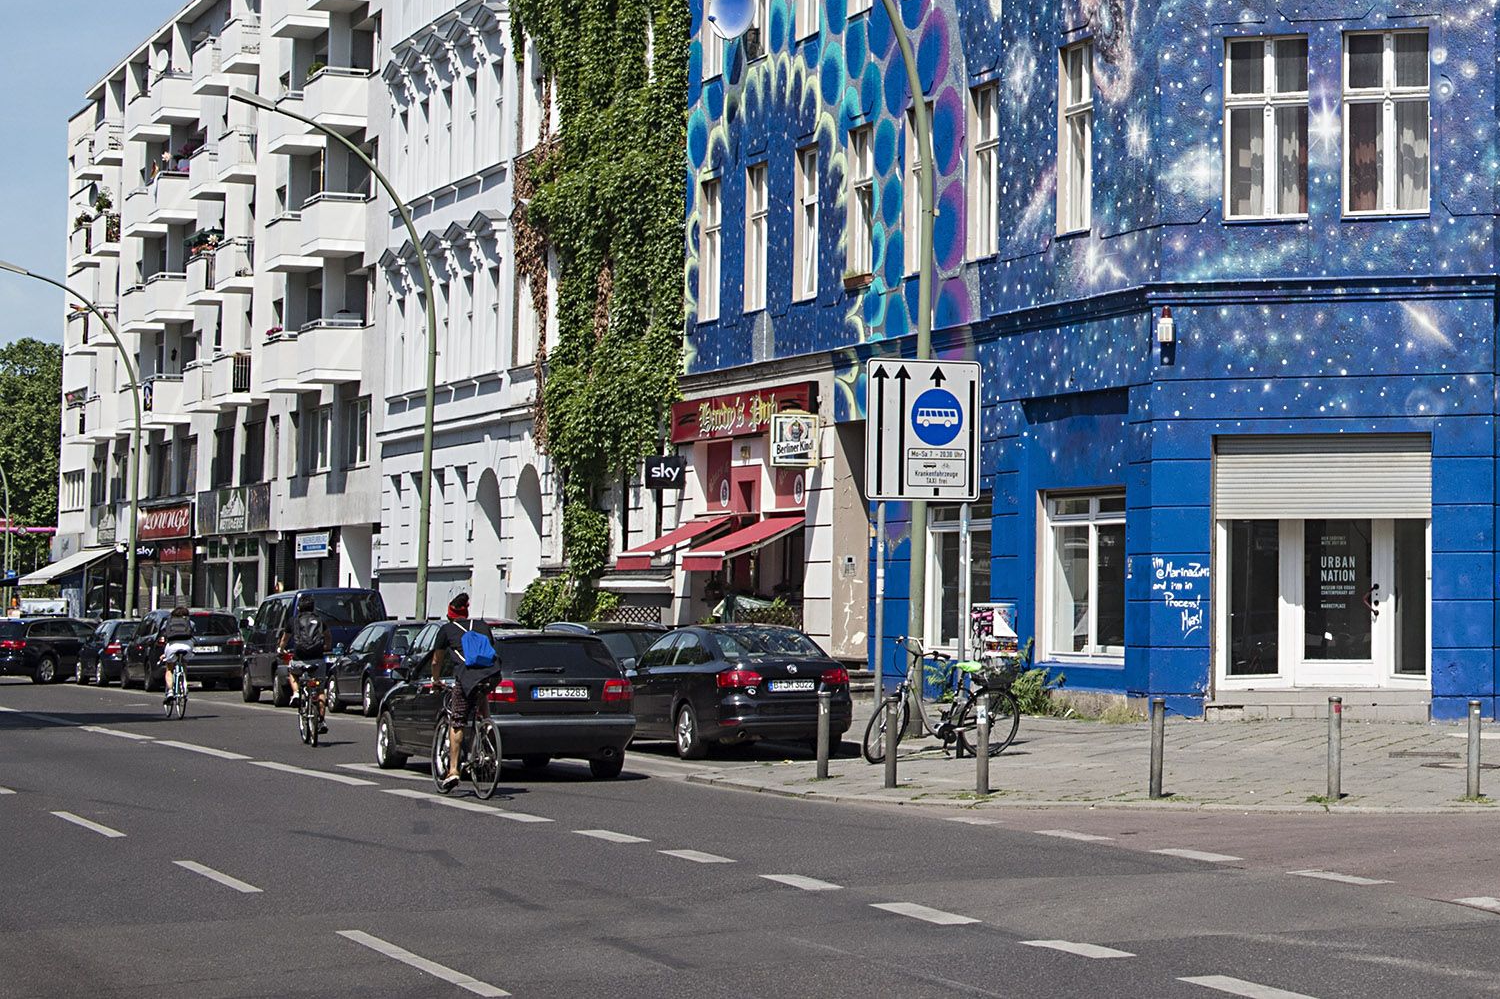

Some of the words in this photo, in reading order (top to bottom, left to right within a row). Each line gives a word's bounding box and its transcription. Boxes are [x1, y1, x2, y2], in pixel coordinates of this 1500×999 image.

[776, 442, 800, 455] Berliner
[651, 462, 681, 482] sky
[914, 469, 958, 479] Krankenfahrzeuge
[143, 507, 190, 533] LOUNGE
[136, 545, 154, 557] sky
[1320, 556, 1356, 569] URBAN
[1320, 569, 1356, 582] NATION
[1152, 580, 1167, 590] and
[1184, 581, 1193, 590] in
[1163, 591, 1202, 610] Process!
